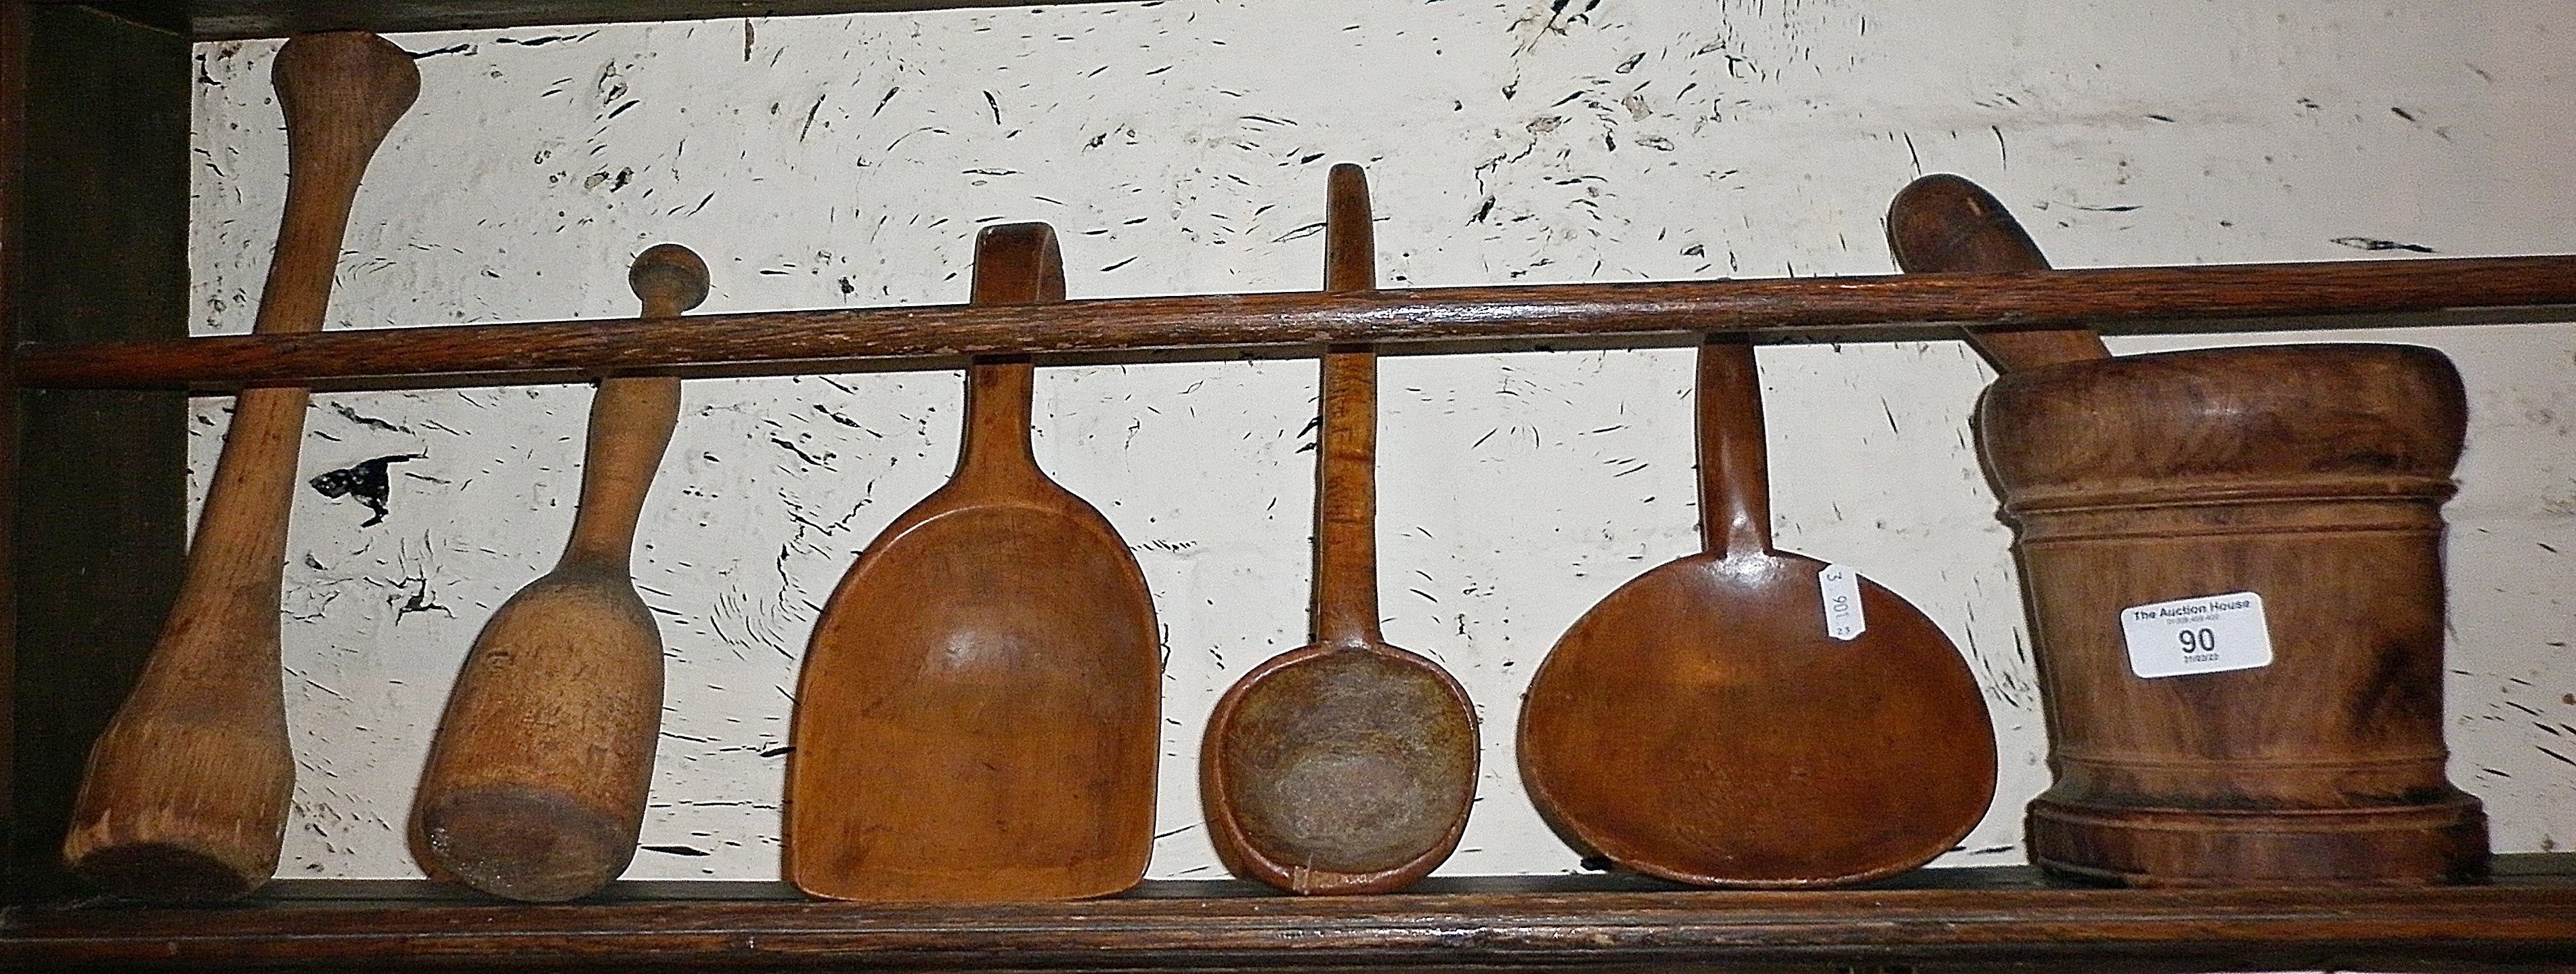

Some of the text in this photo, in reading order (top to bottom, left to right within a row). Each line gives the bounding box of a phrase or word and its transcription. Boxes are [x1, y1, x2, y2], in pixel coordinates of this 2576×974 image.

[2134, 611, 2156, 620] The
[2160, 604, 2207, 617] Auction
[2210, 599, 2250, 612] House
[2179, 627, 2215, 654] 90
